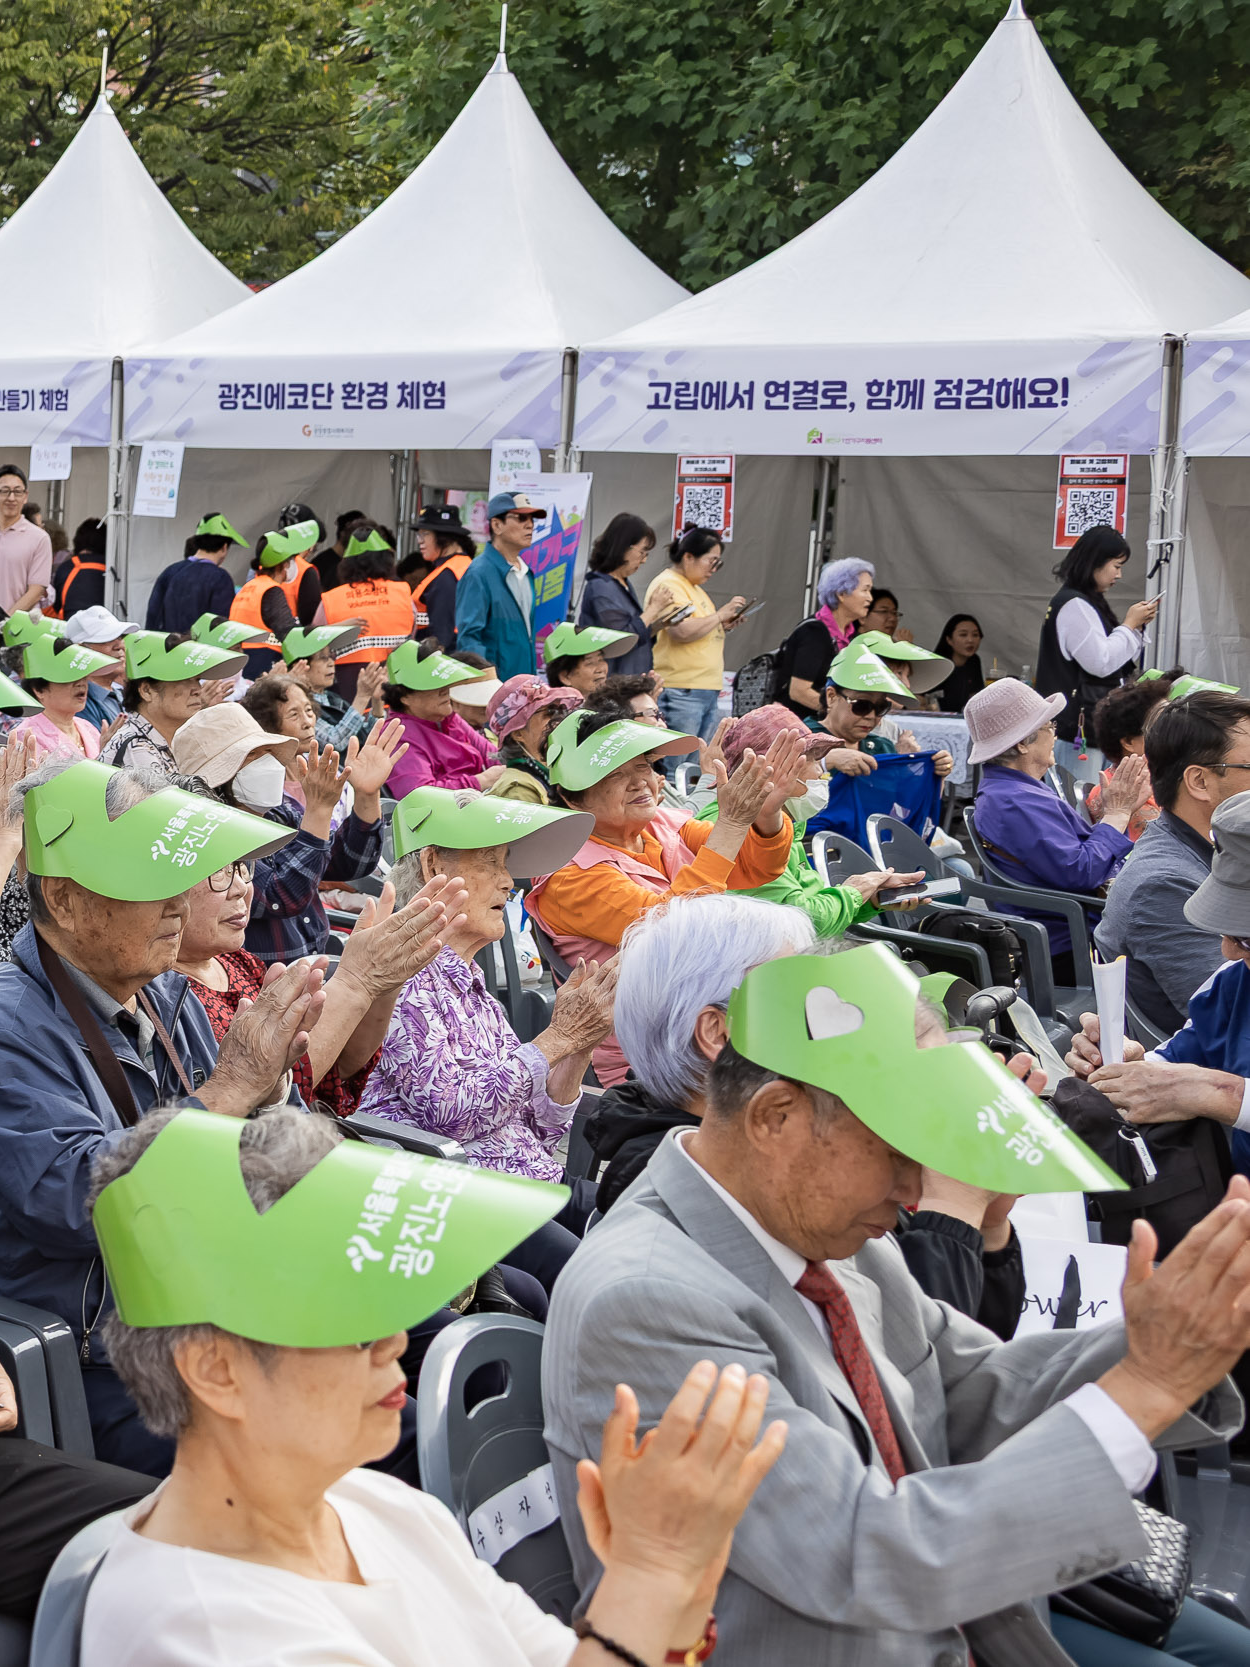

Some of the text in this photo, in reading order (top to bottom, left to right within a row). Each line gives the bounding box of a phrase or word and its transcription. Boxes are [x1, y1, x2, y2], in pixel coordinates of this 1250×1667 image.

[39, 388, 69, 412] 체험
[218, 380, 447, 411] 광진에코단 환경 체험
[646, 376, 1070, 413] 고립에서 연결로, 함께 점검해요!
